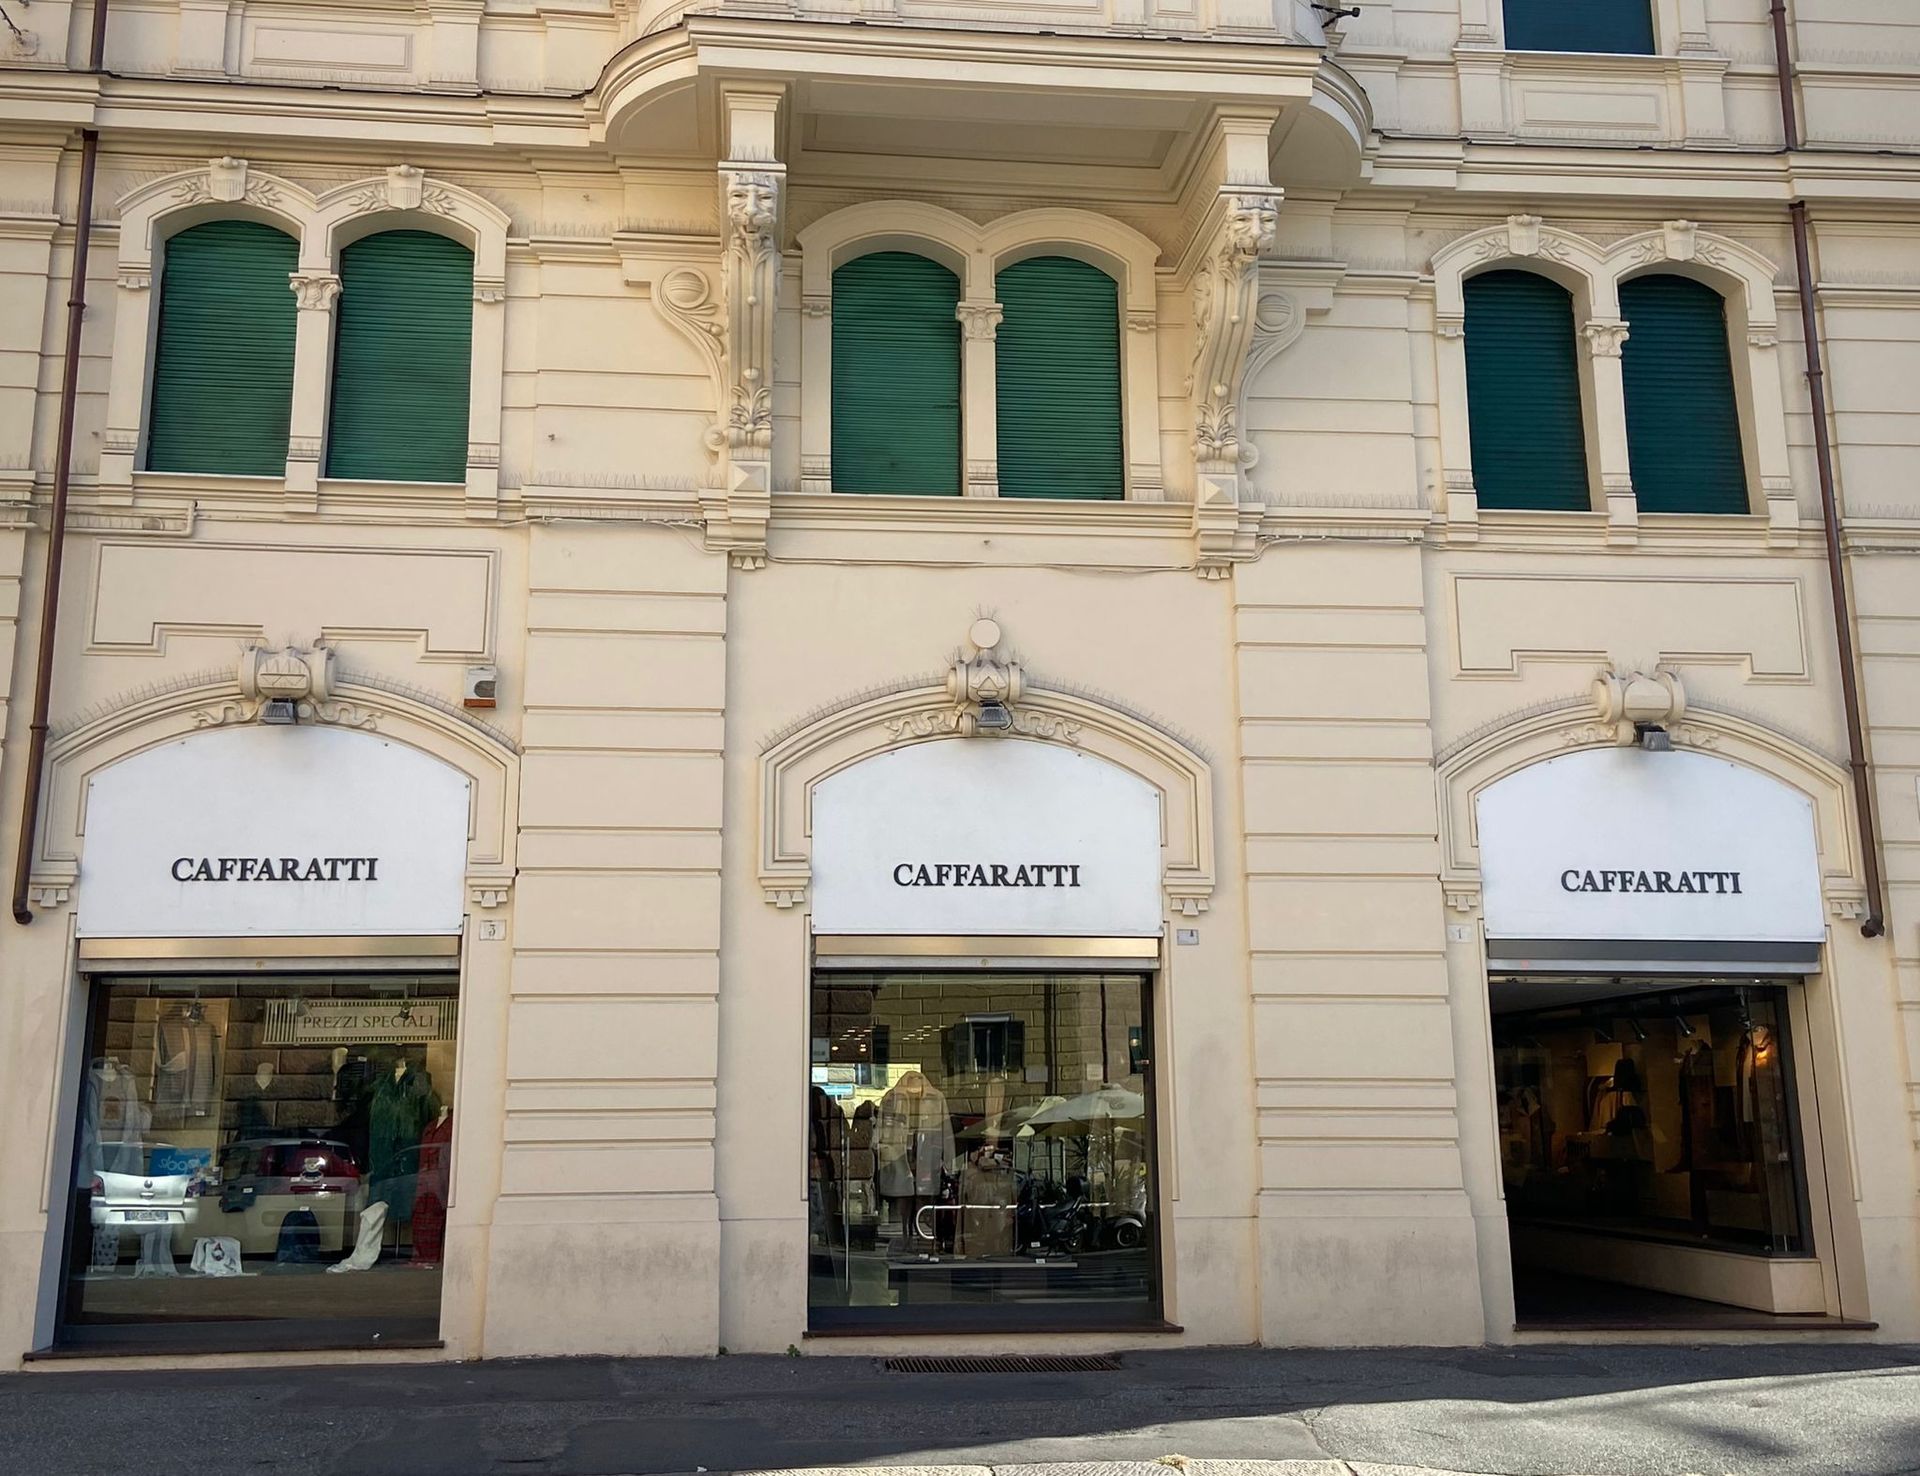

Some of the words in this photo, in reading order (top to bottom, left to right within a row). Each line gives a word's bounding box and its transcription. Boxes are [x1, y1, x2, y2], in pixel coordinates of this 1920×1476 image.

[171, 857, 379, 881] CAFFARATTI
[893, 863, 1080, 887] CAFFARATTI
[1560, 869, 1742, 893] CAFFARATTI
[303, 1015, 358, 1029] PREZZI
[363, 1015, 433, 1028] SPECIALI
